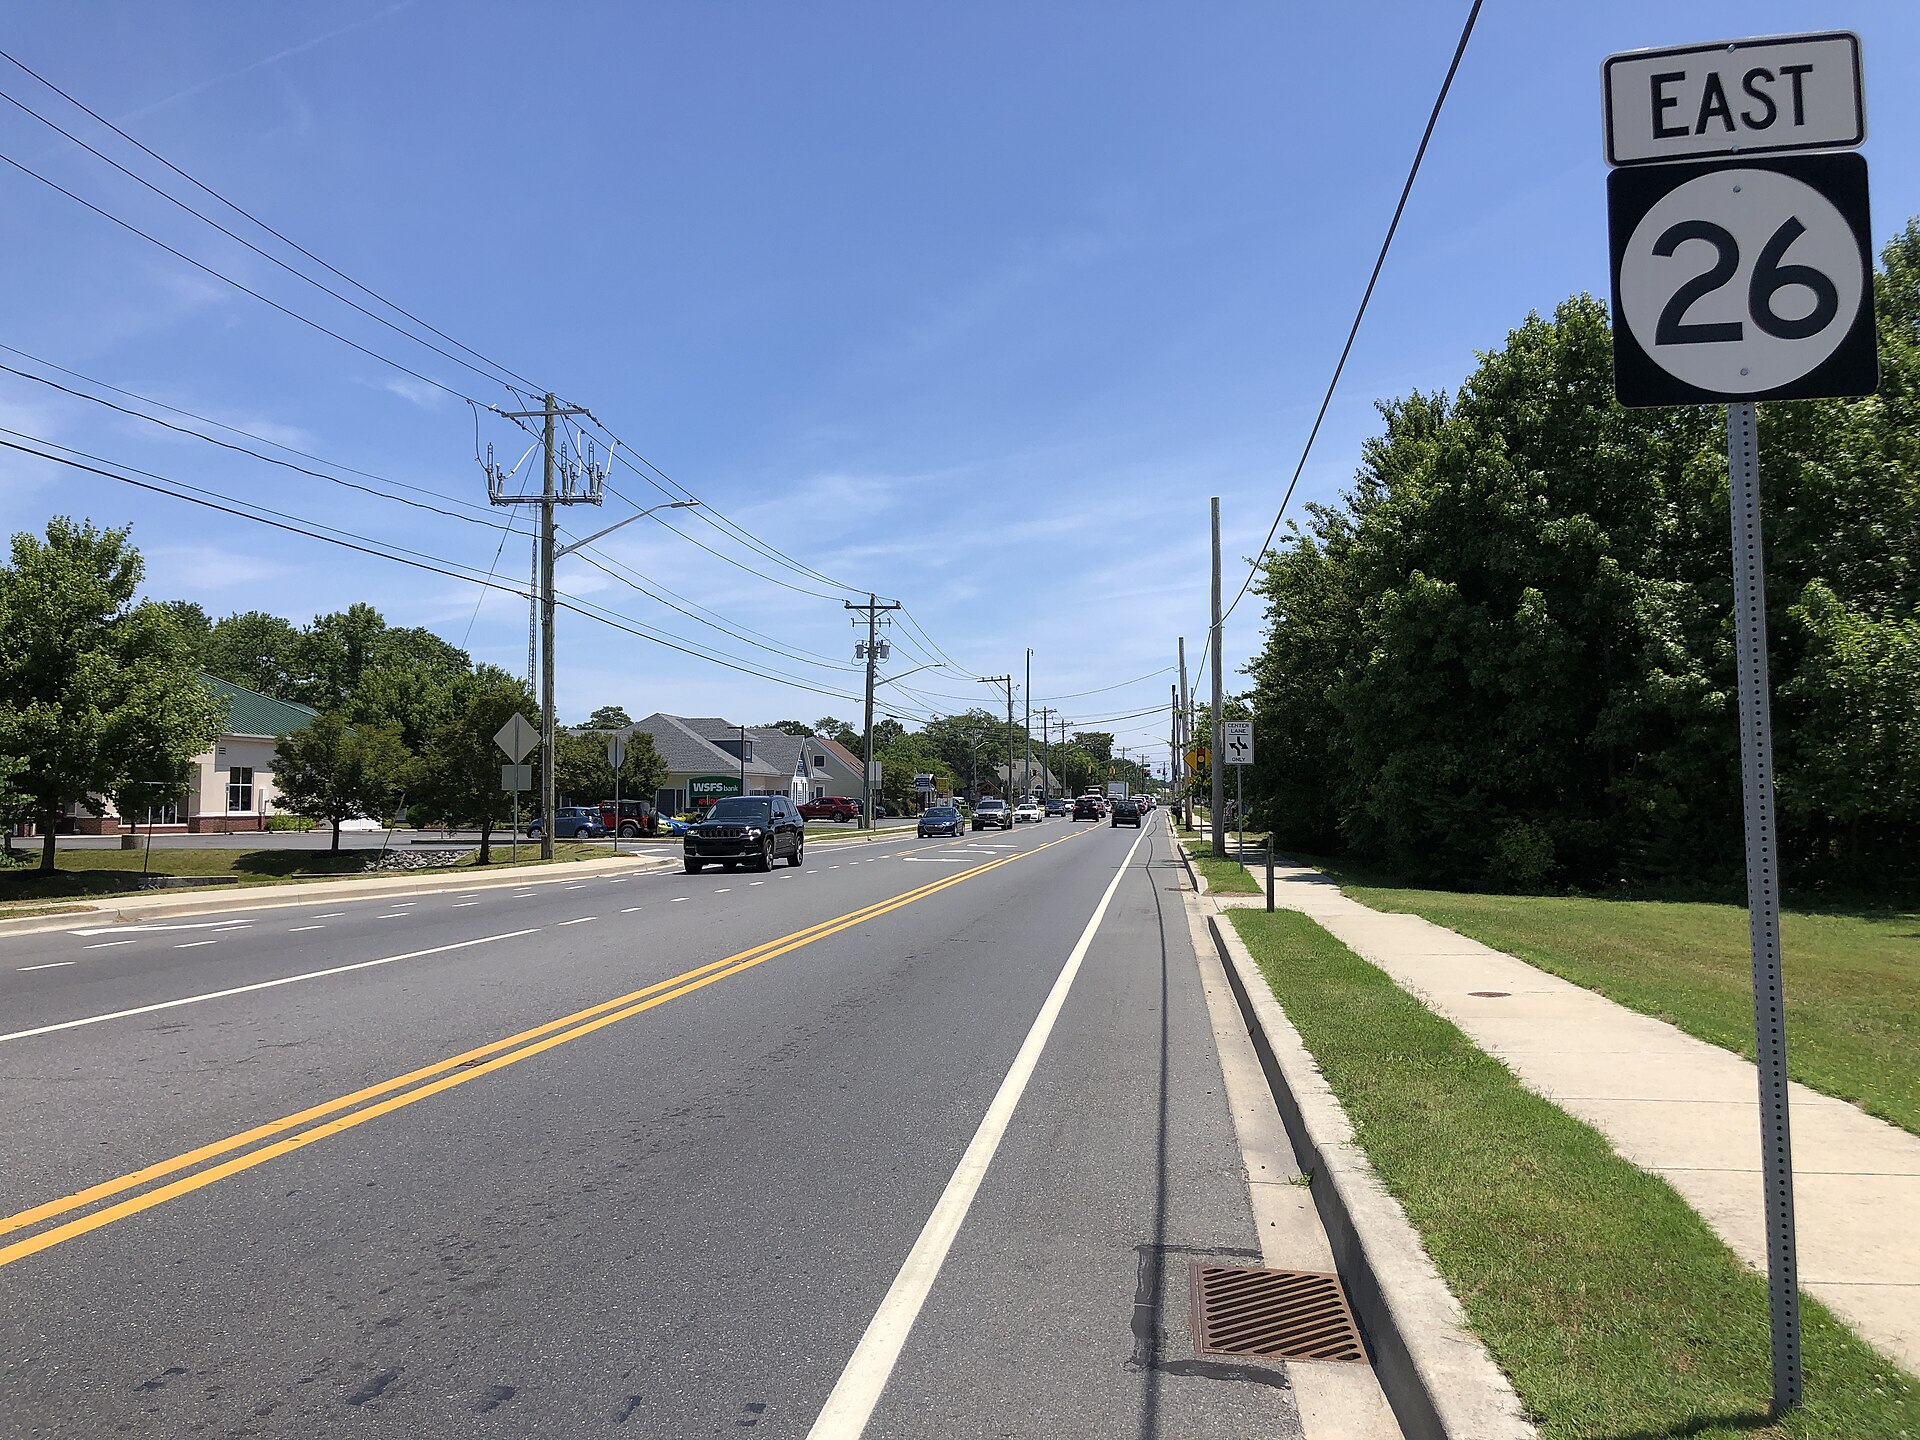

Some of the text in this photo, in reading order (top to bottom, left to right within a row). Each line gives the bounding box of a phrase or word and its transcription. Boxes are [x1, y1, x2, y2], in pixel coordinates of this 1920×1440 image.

[1650, 64, 1813, 140] EAST
[1651, 215, 1839, 346] 26
[693, 782, 723, 792] WSFS
